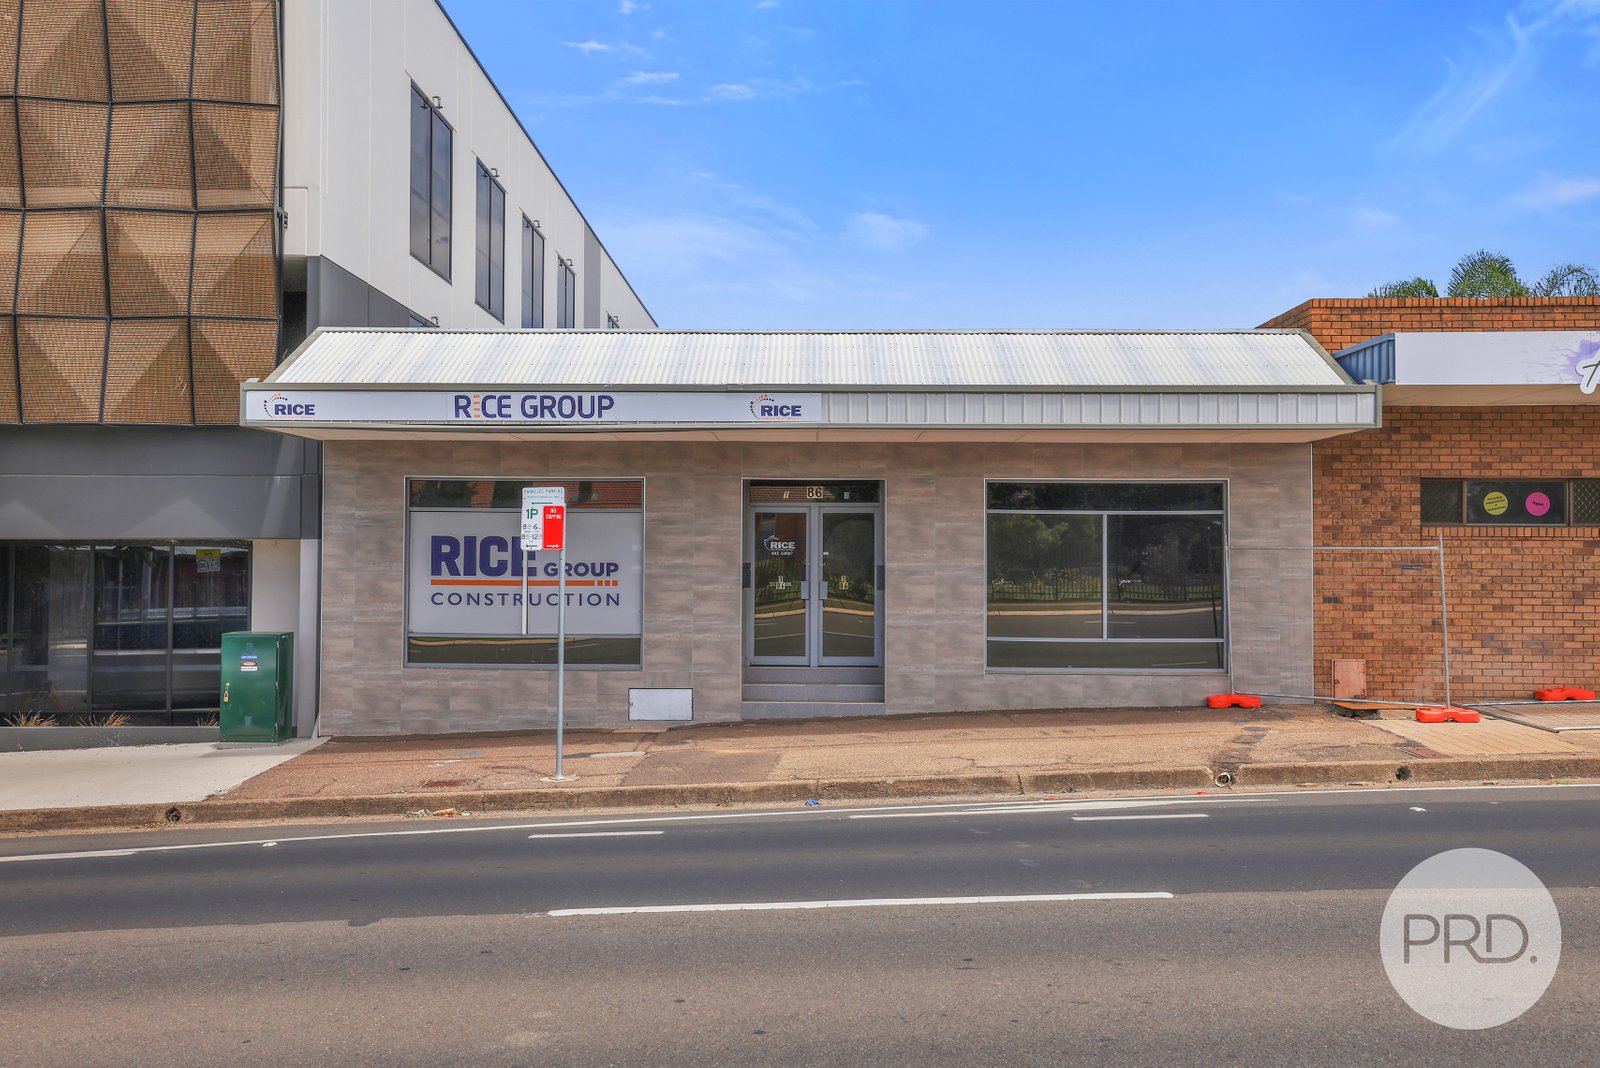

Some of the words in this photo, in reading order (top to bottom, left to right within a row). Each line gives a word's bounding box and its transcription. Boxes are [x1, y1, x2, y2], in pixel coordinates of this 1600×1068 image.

[274, 404, 316, 416] RICE
[521, 394, 615, 419] GROUP
[760, 405, 802, 417] RICE
[807, 486, 823, 498] 86
[526, 508, 538, 519] 1P
[431, 535, 537, 577] RICE
[543, 562, 619, 577] GROUP
[430, 592, 620, 606] CONSTRUCTION
